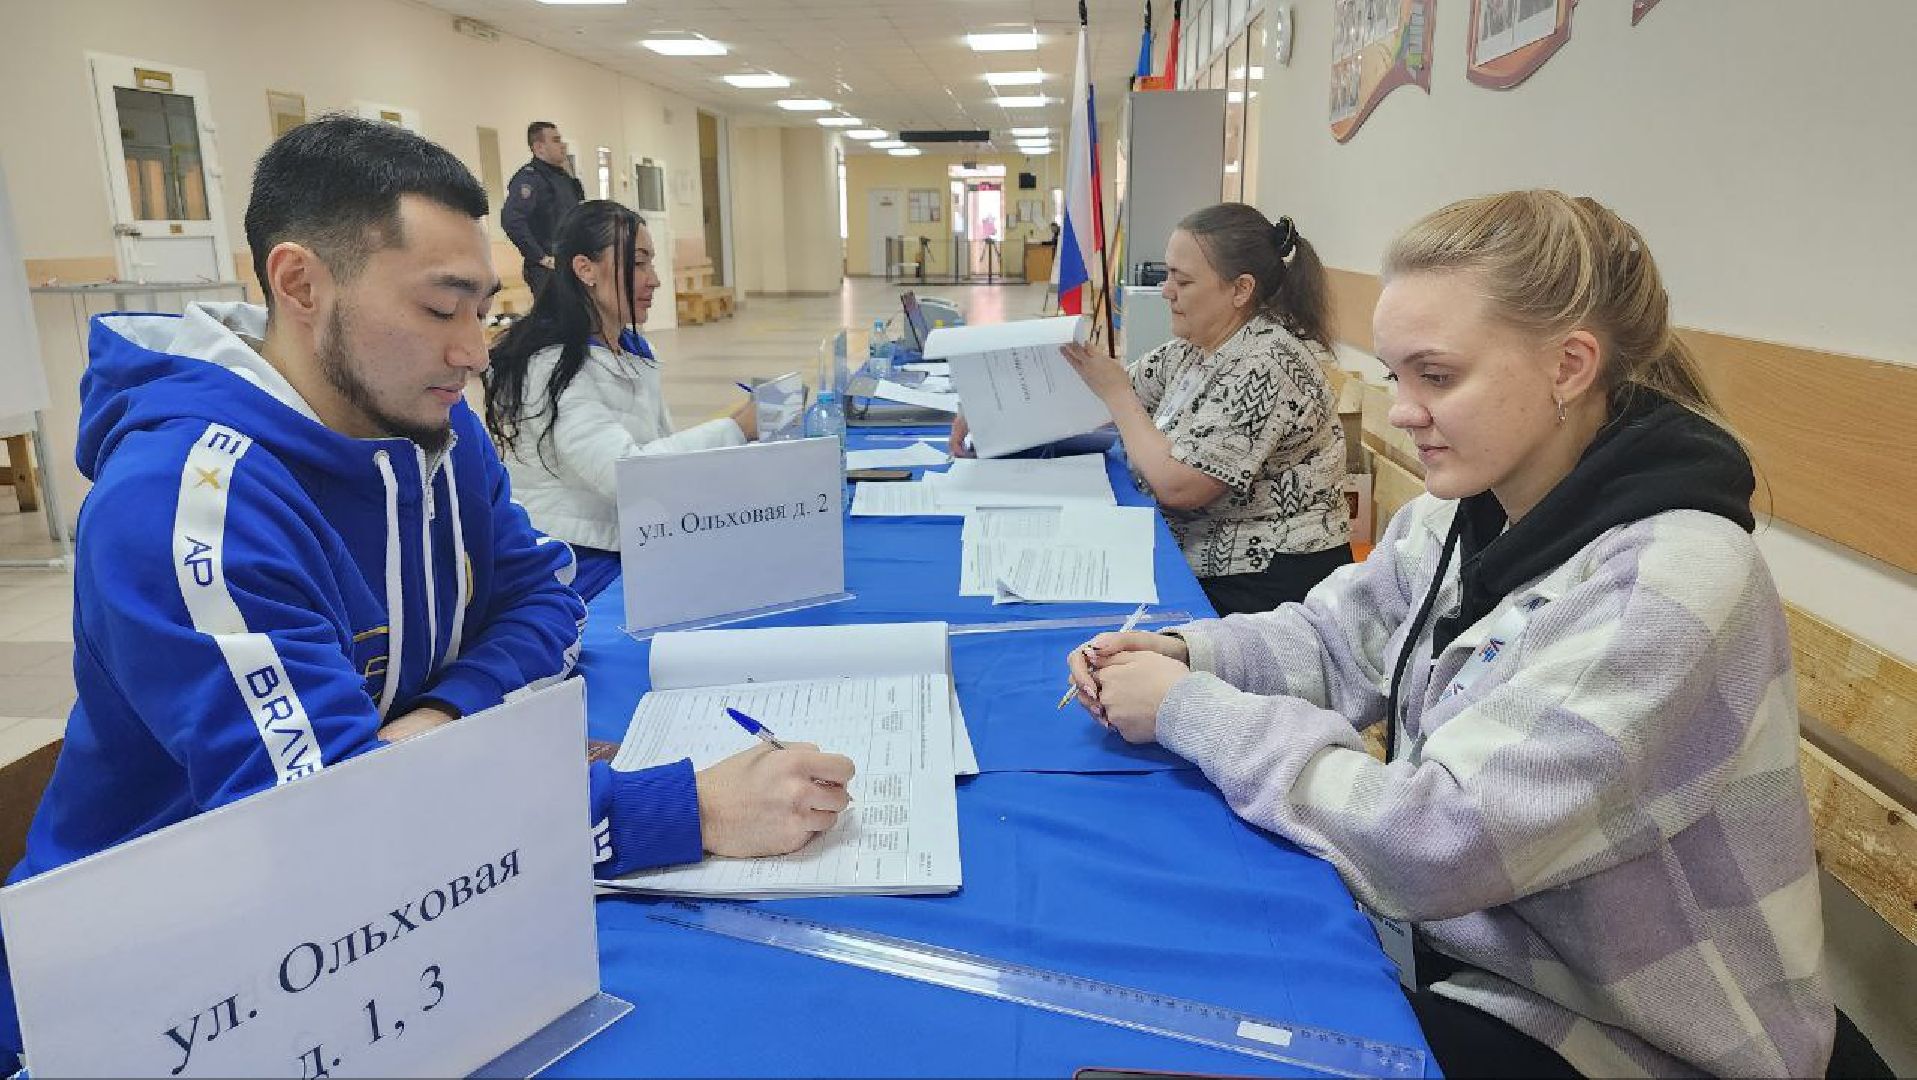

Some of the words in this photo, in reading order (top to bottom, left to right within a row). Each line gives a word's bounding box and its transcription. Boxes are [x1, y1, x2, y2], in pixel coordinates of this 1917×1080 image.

[637, 523, 673, 546] ул.
[681, 503, 787, 534] Ольховая
[793, 502, 811, 519] д.
[817, 493, 829, 512] 2
[163, 994, 257, 1076] ул.
[279, 848, 520, 994] Ольховая
[298, 1044, 340, 1079] д.
[363, 999, 405, 1044] 1,
[420, 964, 445, 1012] 3
